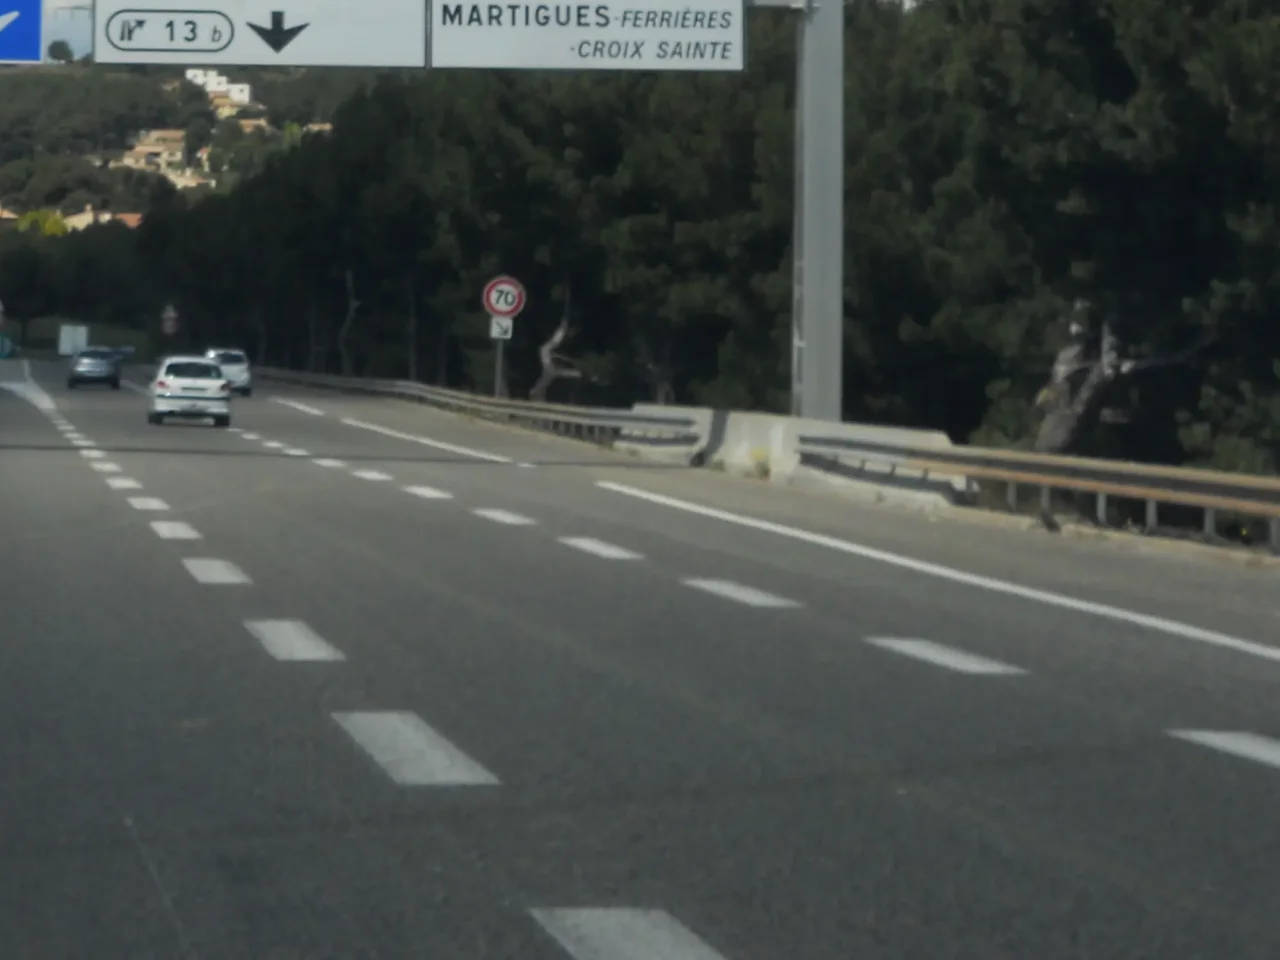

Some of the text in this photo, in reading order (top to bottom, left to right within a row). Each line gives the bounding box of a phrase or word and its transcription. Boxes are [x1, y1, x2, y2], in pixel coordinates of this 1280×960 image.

[166, 20, 198, 43] 13
[655, 41, 734, 60] SAINTE
[495, 289, 517, 307] 70
